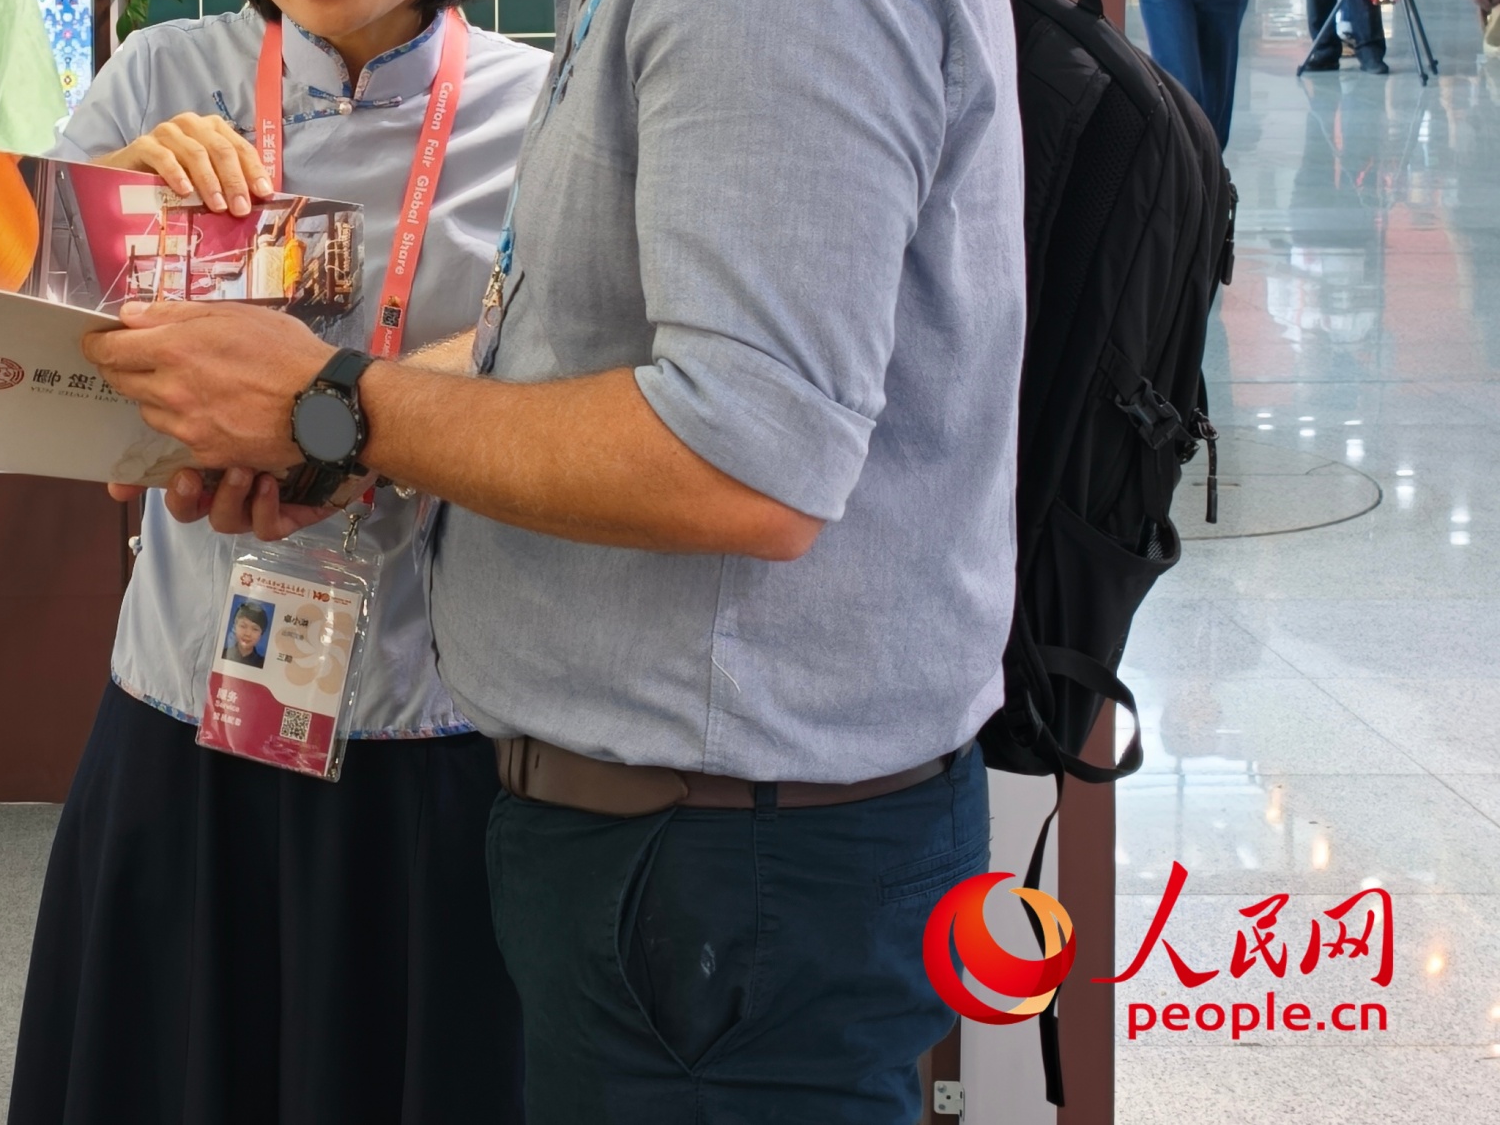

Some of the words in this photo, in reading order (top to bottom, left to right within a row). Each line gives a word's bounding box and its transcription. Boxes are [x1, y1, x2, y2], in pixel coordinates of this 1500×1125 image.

[430, 81, 454, 131] Canton
[421, 138, 440, 169] Fair
[407, 175, 430, 225] Global
[395, 232, 415, 276] Share
